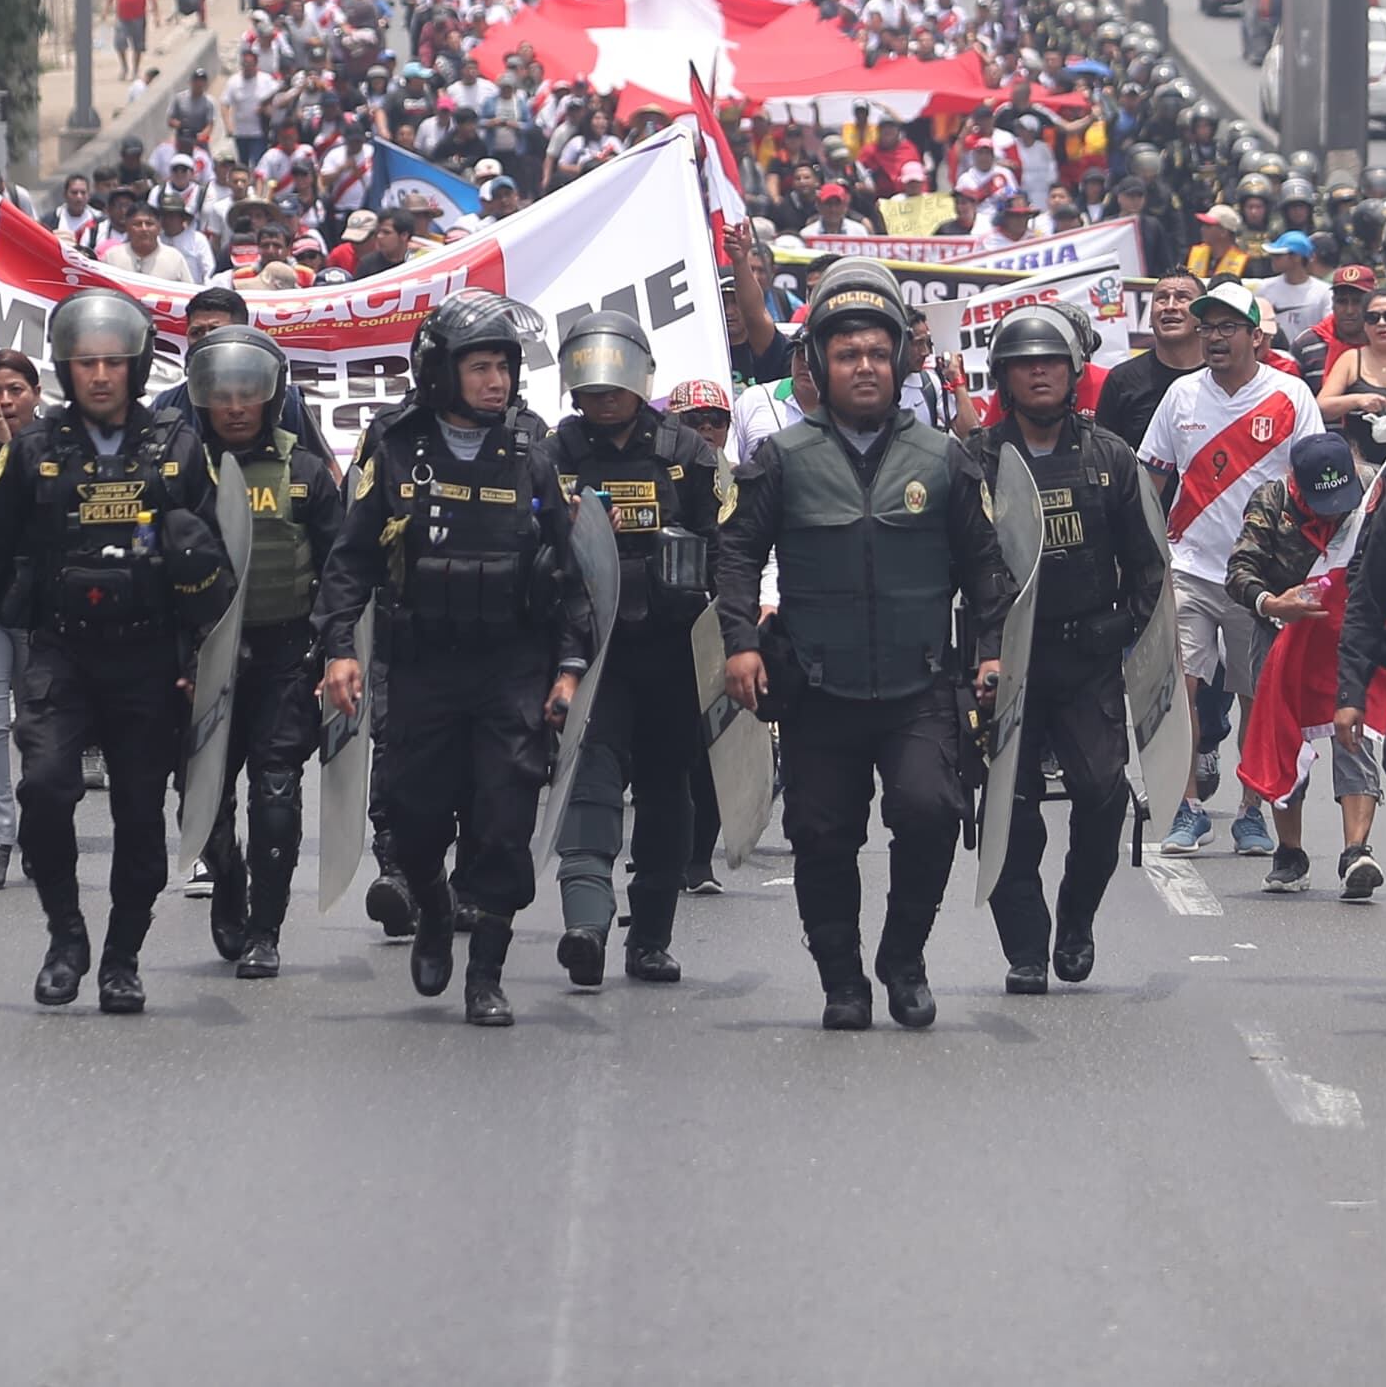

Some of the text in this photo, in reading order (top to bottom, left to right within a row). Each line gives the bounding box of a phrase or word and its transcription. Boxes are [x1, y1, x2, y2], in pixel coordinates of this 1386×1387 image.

[827, 290, 885, 309] POLICIA
[332, 320, 353, 328] de
[361, 310, 435, 329] confianz
[1213, 449, 1228, 482] 9
[1314, 473, 1349, 491] innova
[83, 504, 139, 521] POLICIA
[1042, 516, 1081, 547] LICIA
